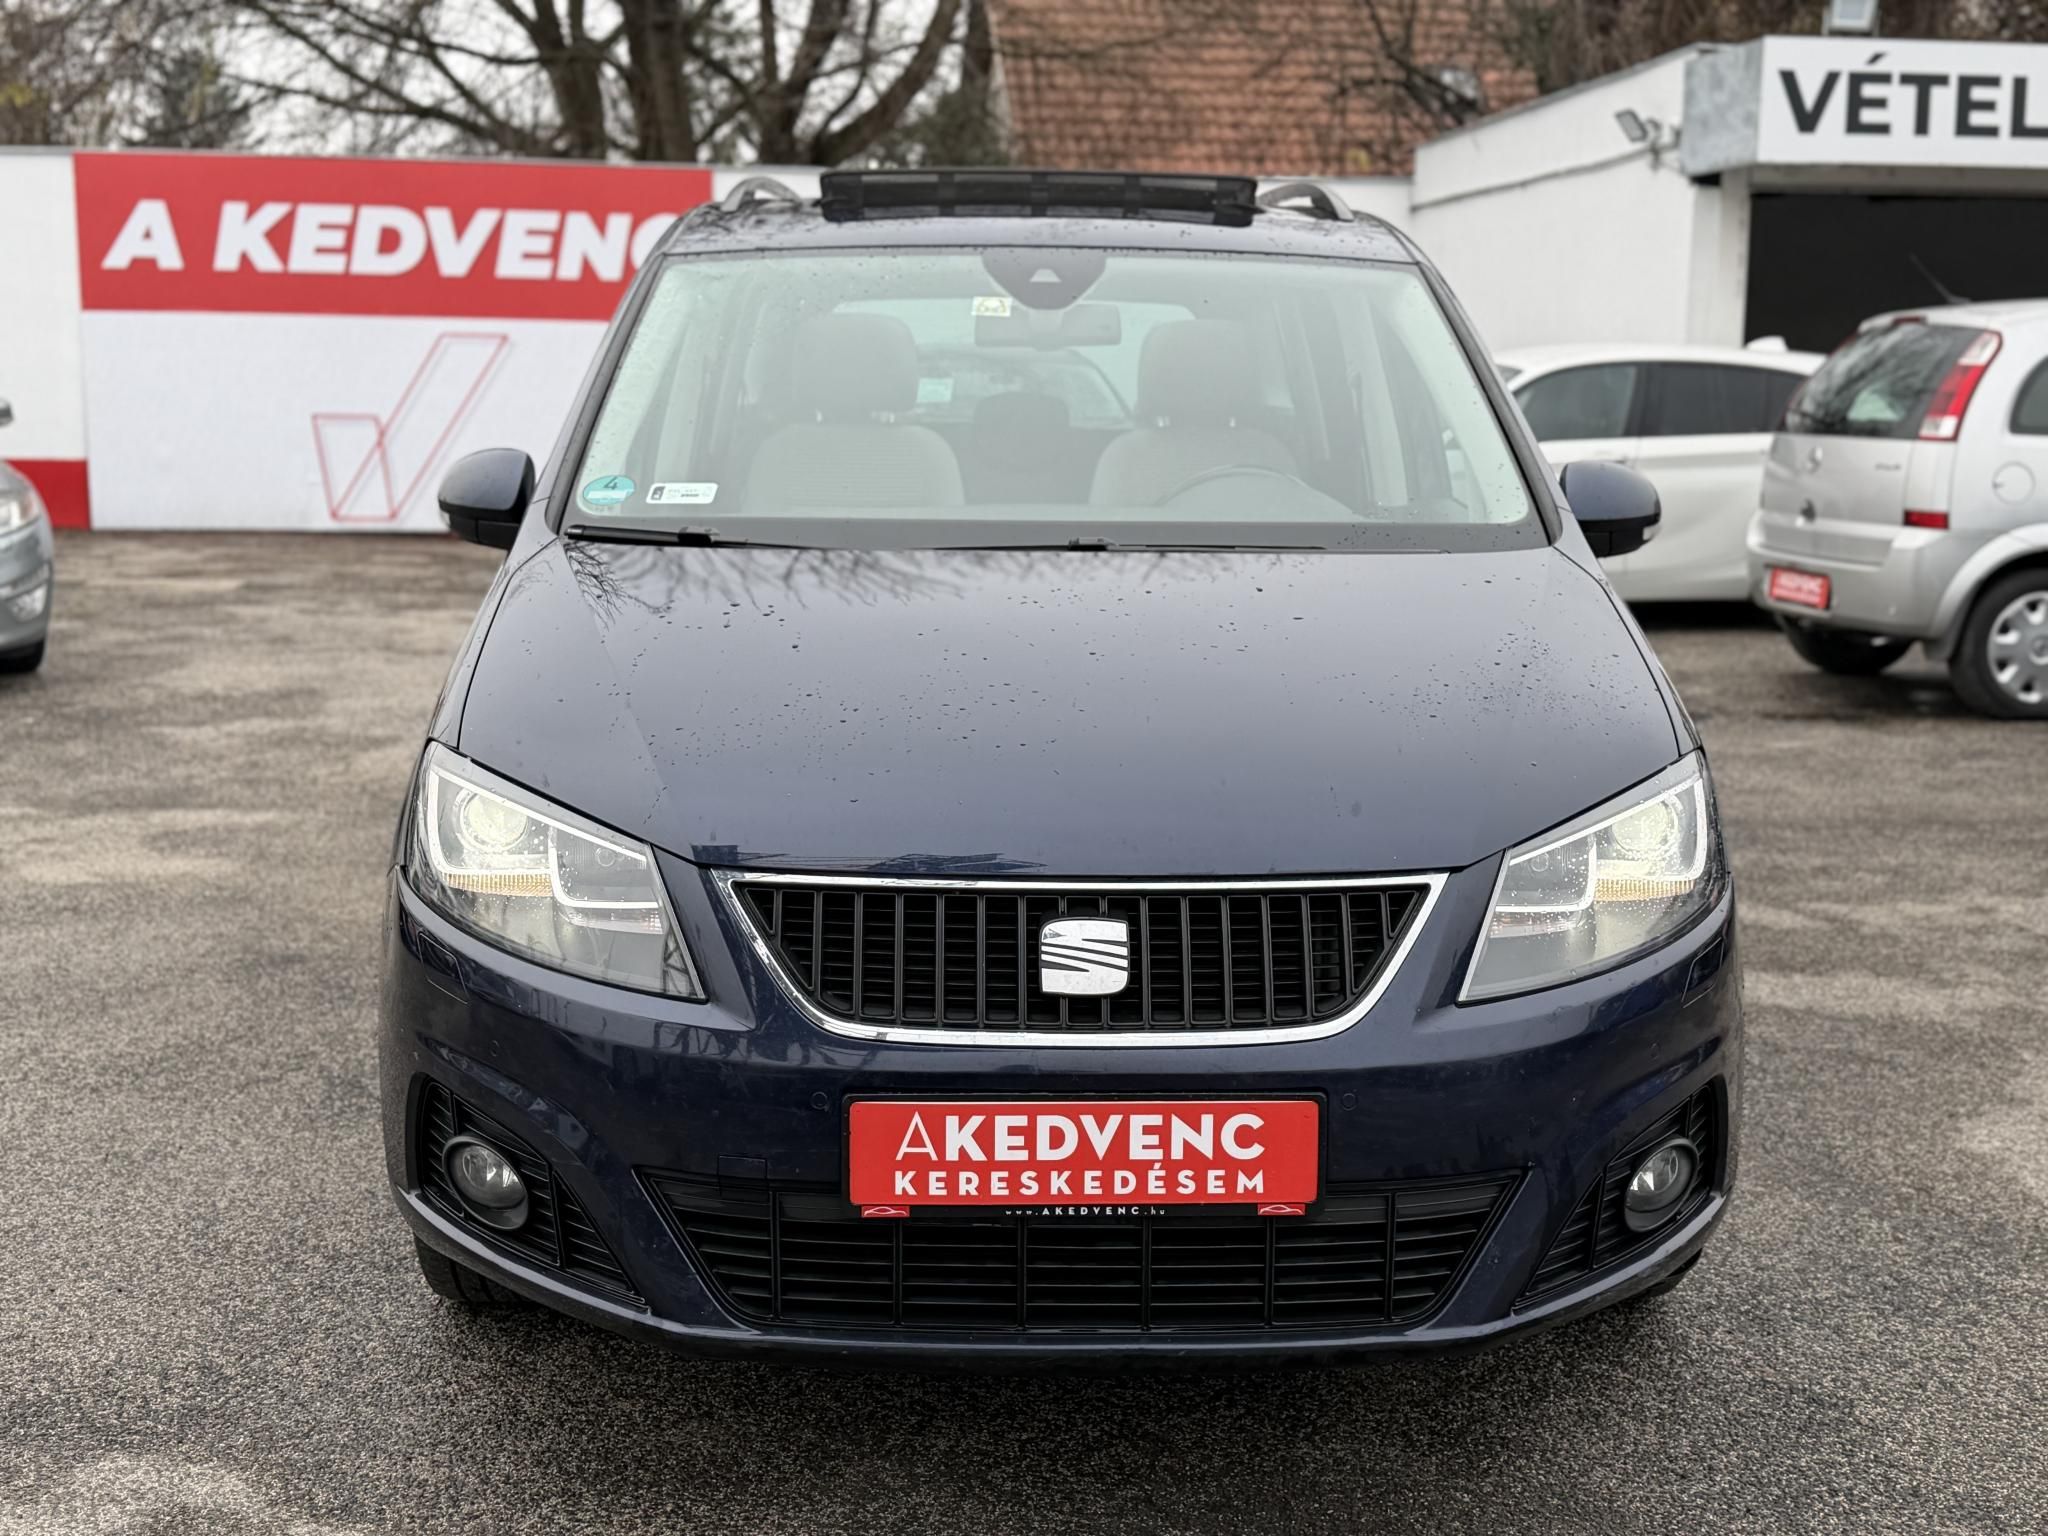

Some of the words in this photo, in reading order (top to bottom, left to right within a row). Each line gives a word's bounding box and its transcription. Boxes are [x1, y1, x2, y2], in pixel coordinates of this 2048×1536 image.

[1779, 53, 2048, 138] VÉTEL
[101, 198, 185, 271] A
[603, 476, 617, 490] 4
[894, 1163, 1264, 1196] KERESKEDÉSEM
[1005, 1206, 1165, 1216] www.AKEDVENC.hu
